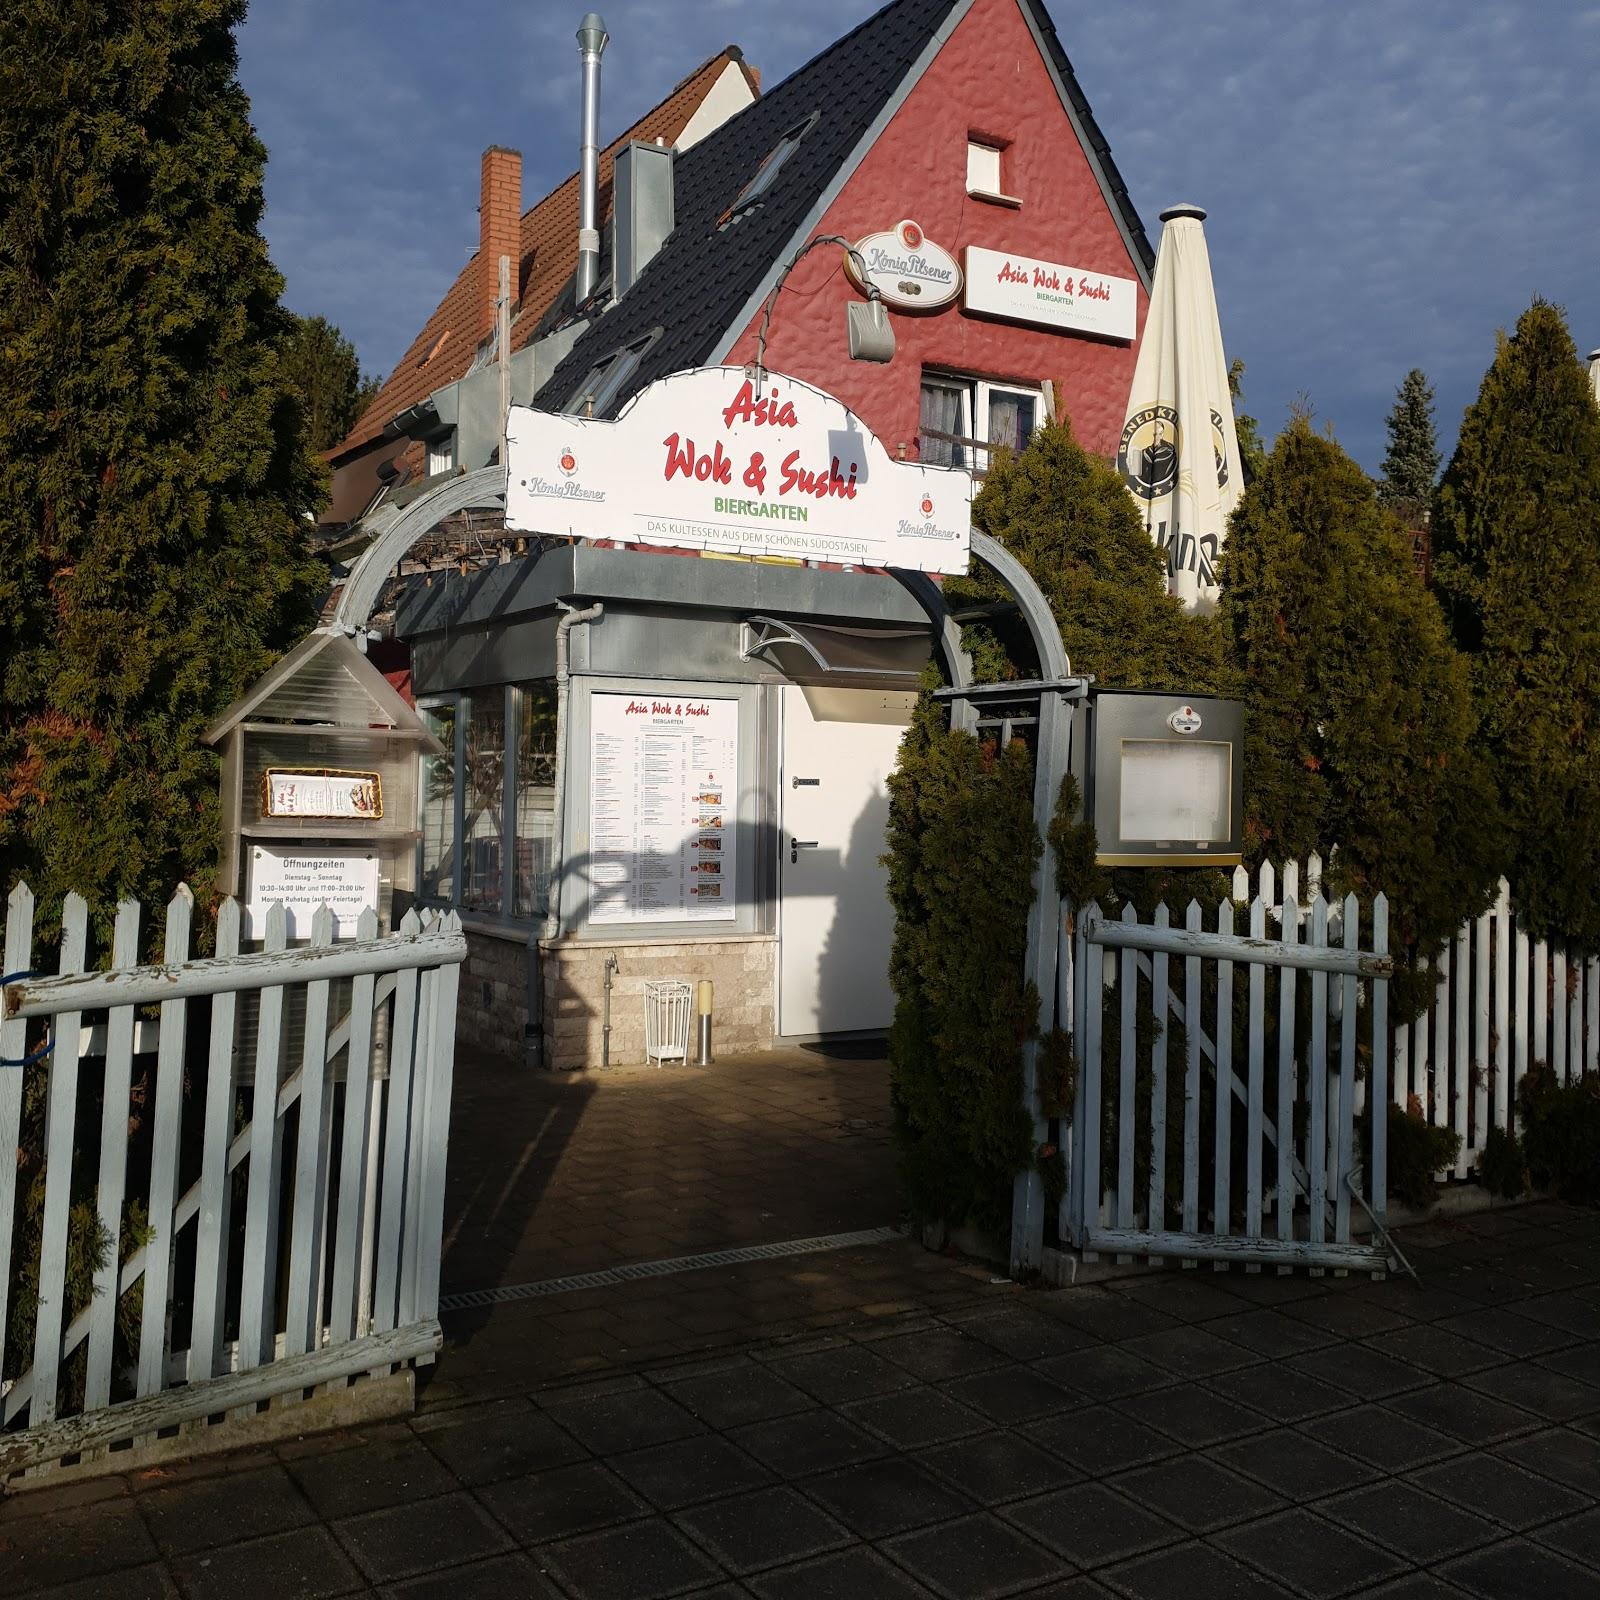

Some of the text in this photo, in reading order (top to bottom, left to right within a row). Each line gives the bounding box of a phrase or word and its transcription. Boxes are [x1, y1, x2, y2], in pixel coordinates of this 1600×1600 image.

[868, 248, 952, 280] König Pilsener
[998, 261, 1110, 301] Asia Wok & Sushi
[1036, 292, 1074, 306] BIERGARTEN
[722, 379, 799, 429] Asia
[663, 432, 858, 500] Wok & Sushi
[528, 477, 606, 499] König Pilsener
[714, 496, 808, 522] BIERGARTEN
[647, 521, 868, 553] DAS KULTESSEN AUS DEM SCHÖNEN SÜDOSTASIEN
[625, 701, 710, 717] Asia Wok & Sushi
[283, 857, 345, 870] Öffnungzeiten
[284, 873, 311, 881] Dienstag
